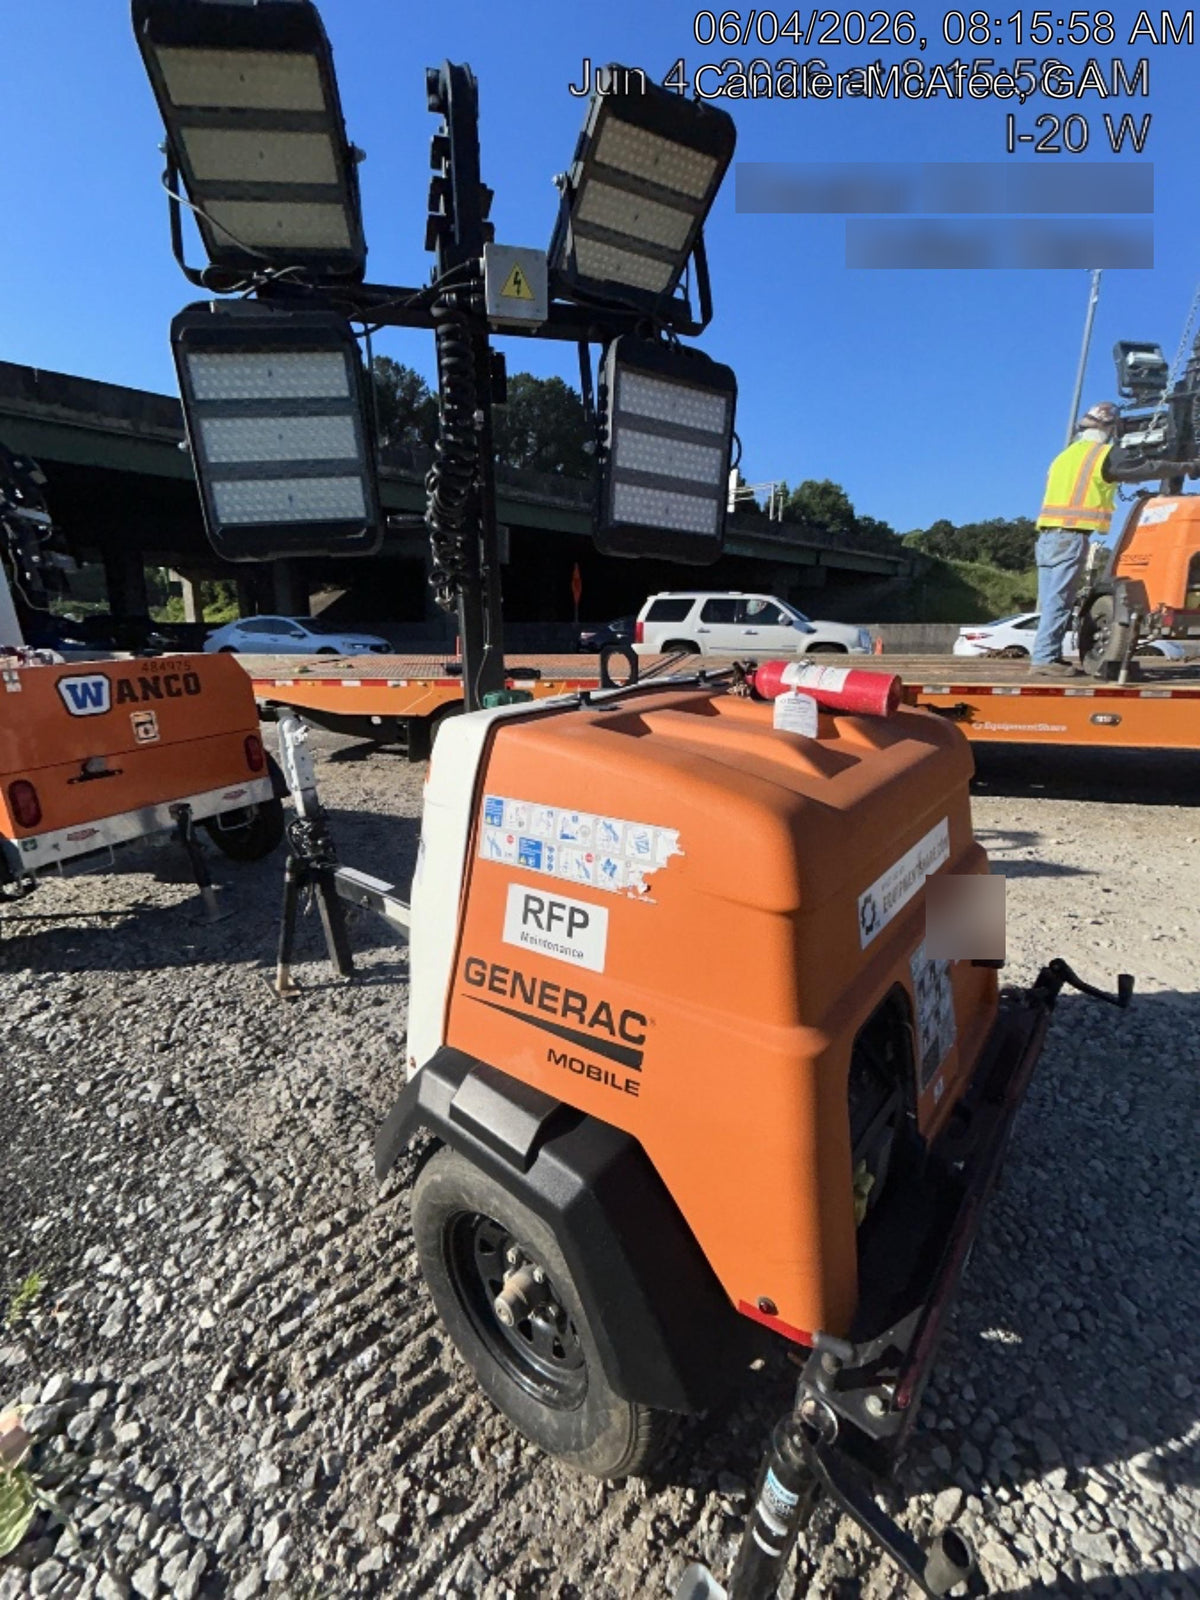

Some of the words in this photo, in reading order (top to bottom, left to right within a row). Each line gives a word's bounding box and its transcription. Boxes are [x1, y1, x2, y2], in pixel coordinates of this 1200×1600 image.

[64, 672, 202, 710] WANCO
[521, 893, 590, 939] RFP
[463, 956, 648, 1046] GENERAC
[546, 1048, 641, 1098] MOBILE
